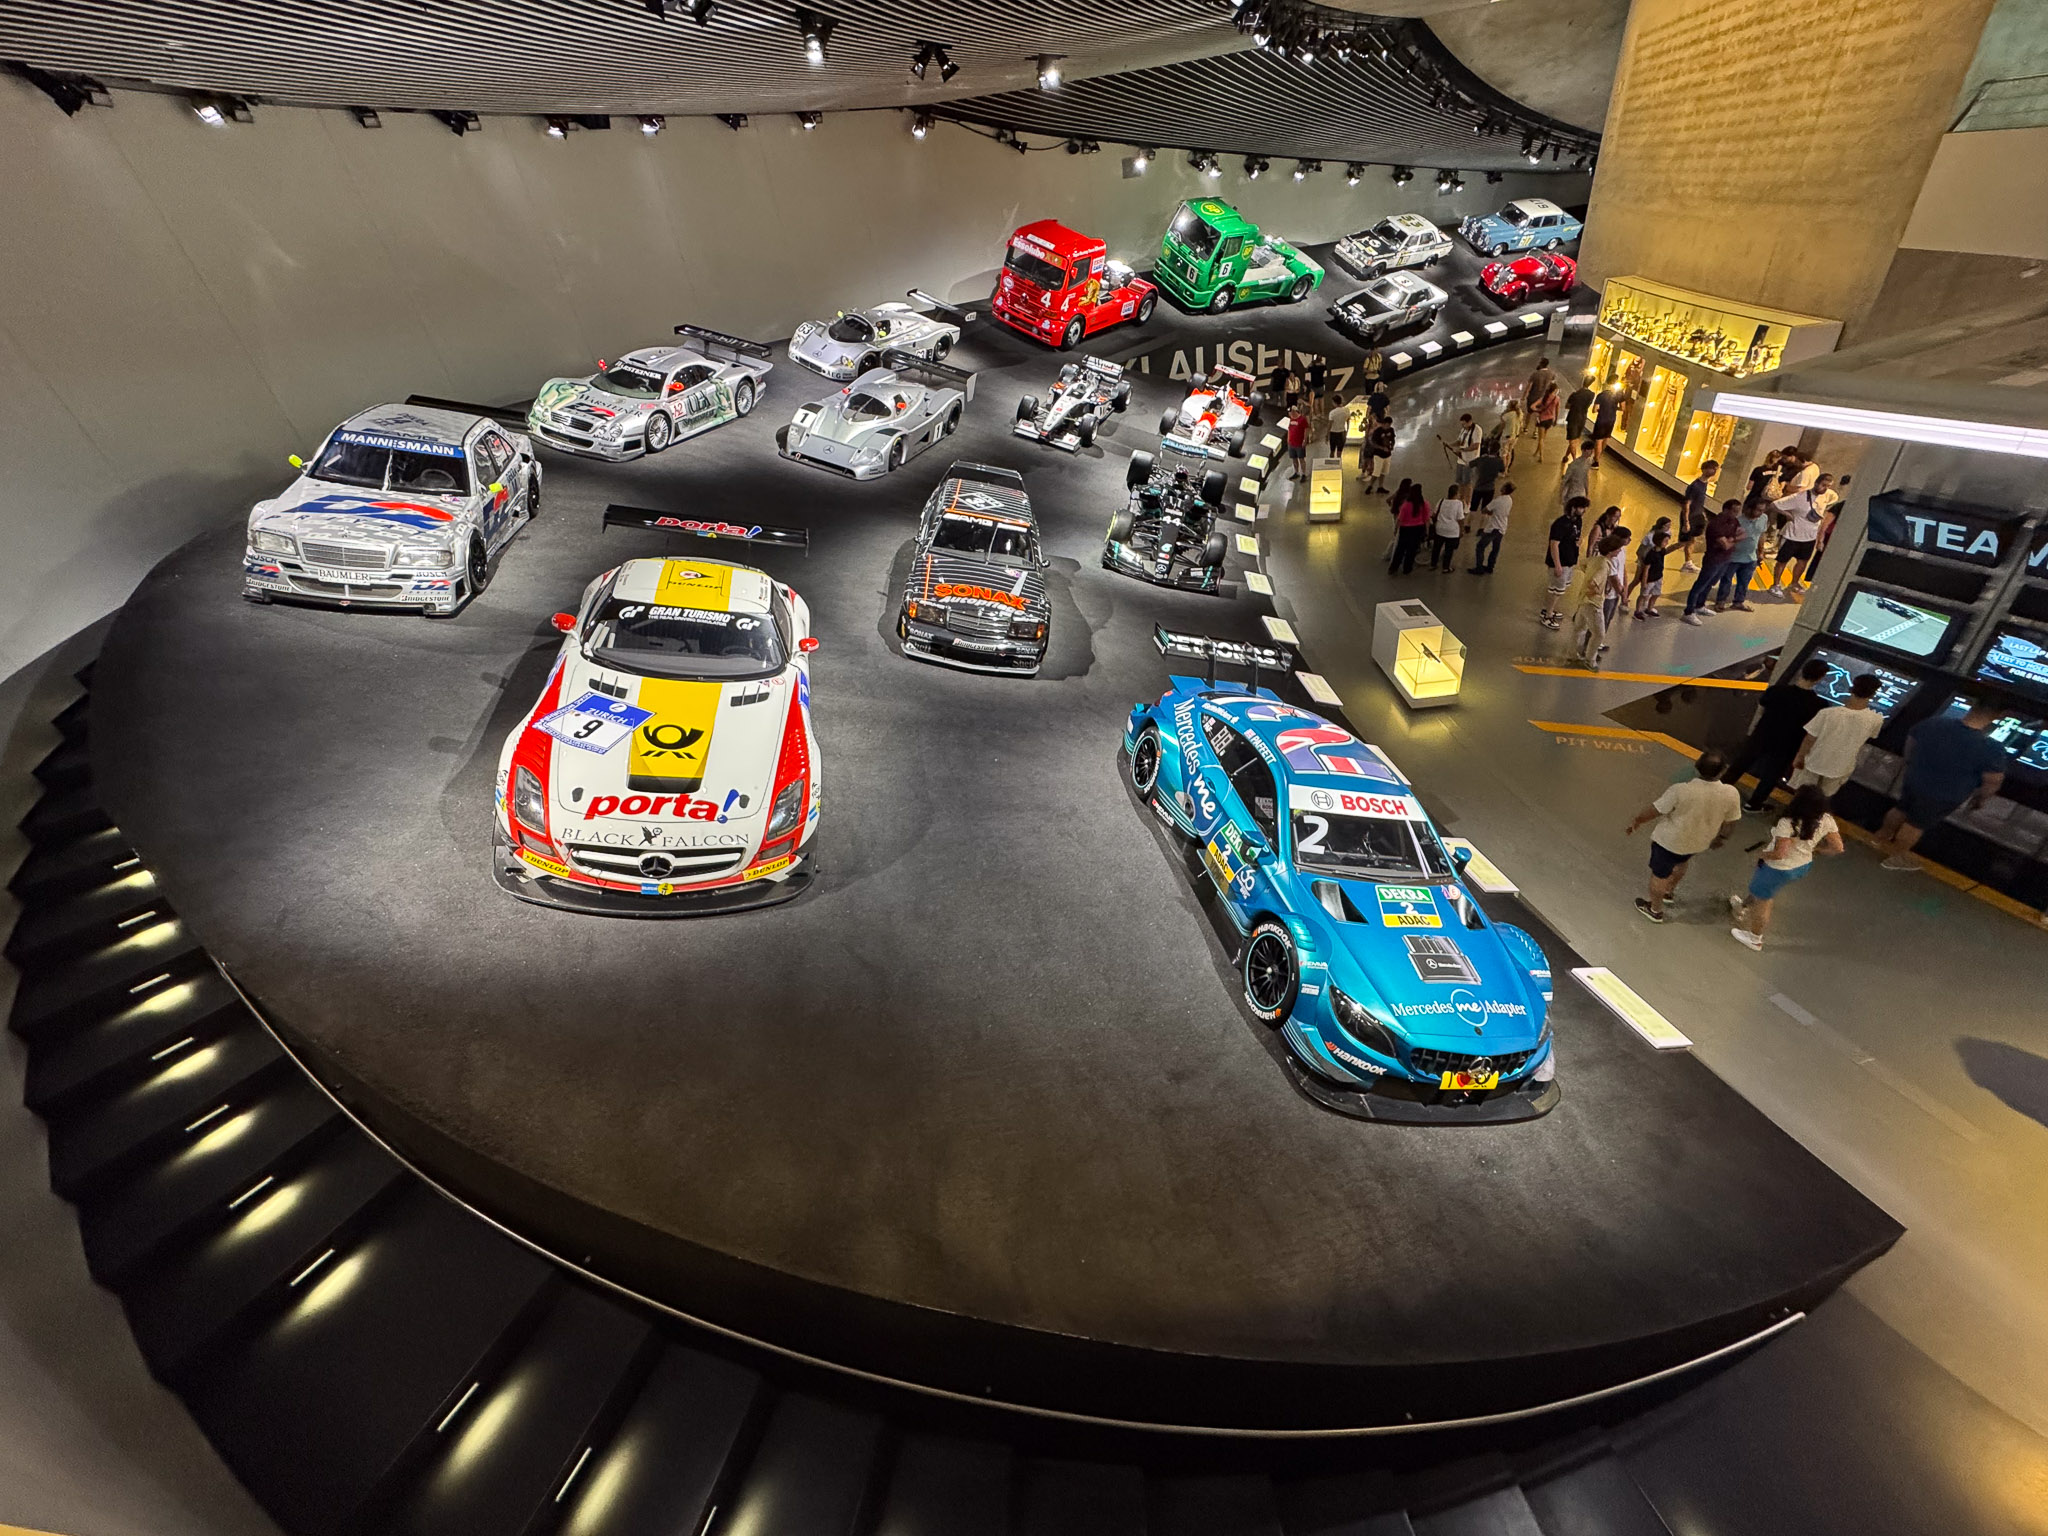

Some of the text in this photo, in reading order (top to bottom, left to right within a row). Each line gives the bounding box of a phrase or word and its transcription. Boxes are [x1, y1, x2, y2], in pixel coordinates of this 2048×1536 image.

[1204, 203, 1220, 214] BP
[1188, 268, 1195, 280] 6
[1222, 264, 1229, 275] 6
[1041, 292, 1051, 308] 4
[1061, 297, 1069, 312] 4
[801, 323, 814, 335] 63
[802, 413, 810, 423] 1
[936, 427, 943, 439] 1
[340, 432, 455, 456] MANNESMANN
[655, 516, 762, 539] porta!
[1162, 515, 1180, 527] 44
[1905, 516, 1999, 558] TEA
[933, 583, 1027, 611] SONAX
[649, 606, 731, 623] GRAN TURISMO
[909, 627, 935, 640] SONAX
[1016, 646, 1040, 655] SONAX
[585, 707, 628, 723] ZURICH
[573, 719, 604, 739] 9
[1250, 735, 1277, 764] PAFFETT
[1555, 736, 1650, 754] PIT WALL
[1173, 697, 1216, 820] Mercedes me
[584, 789, 740, 824] porta!
[1340, 794, 1409, 816] BOSCH
[561, 827, 750, 847] BLACK FALCON
[1297, 815, 1330, 855] 2
[1222, 843, 1232, 862] 2
[530, 856, 569, 875] DUNLOP
[751, 858, 789, 876] DUNLOP
[1213, 850, 1229, 875] ADAC
[1379, 887, 1430, 901] DEKRA
[1400, 901, 1419, 915] 2
[1397, 914, 1431, 926] ADAC
[1390, 999, 1528, 1018] Mercedes me Adapter
